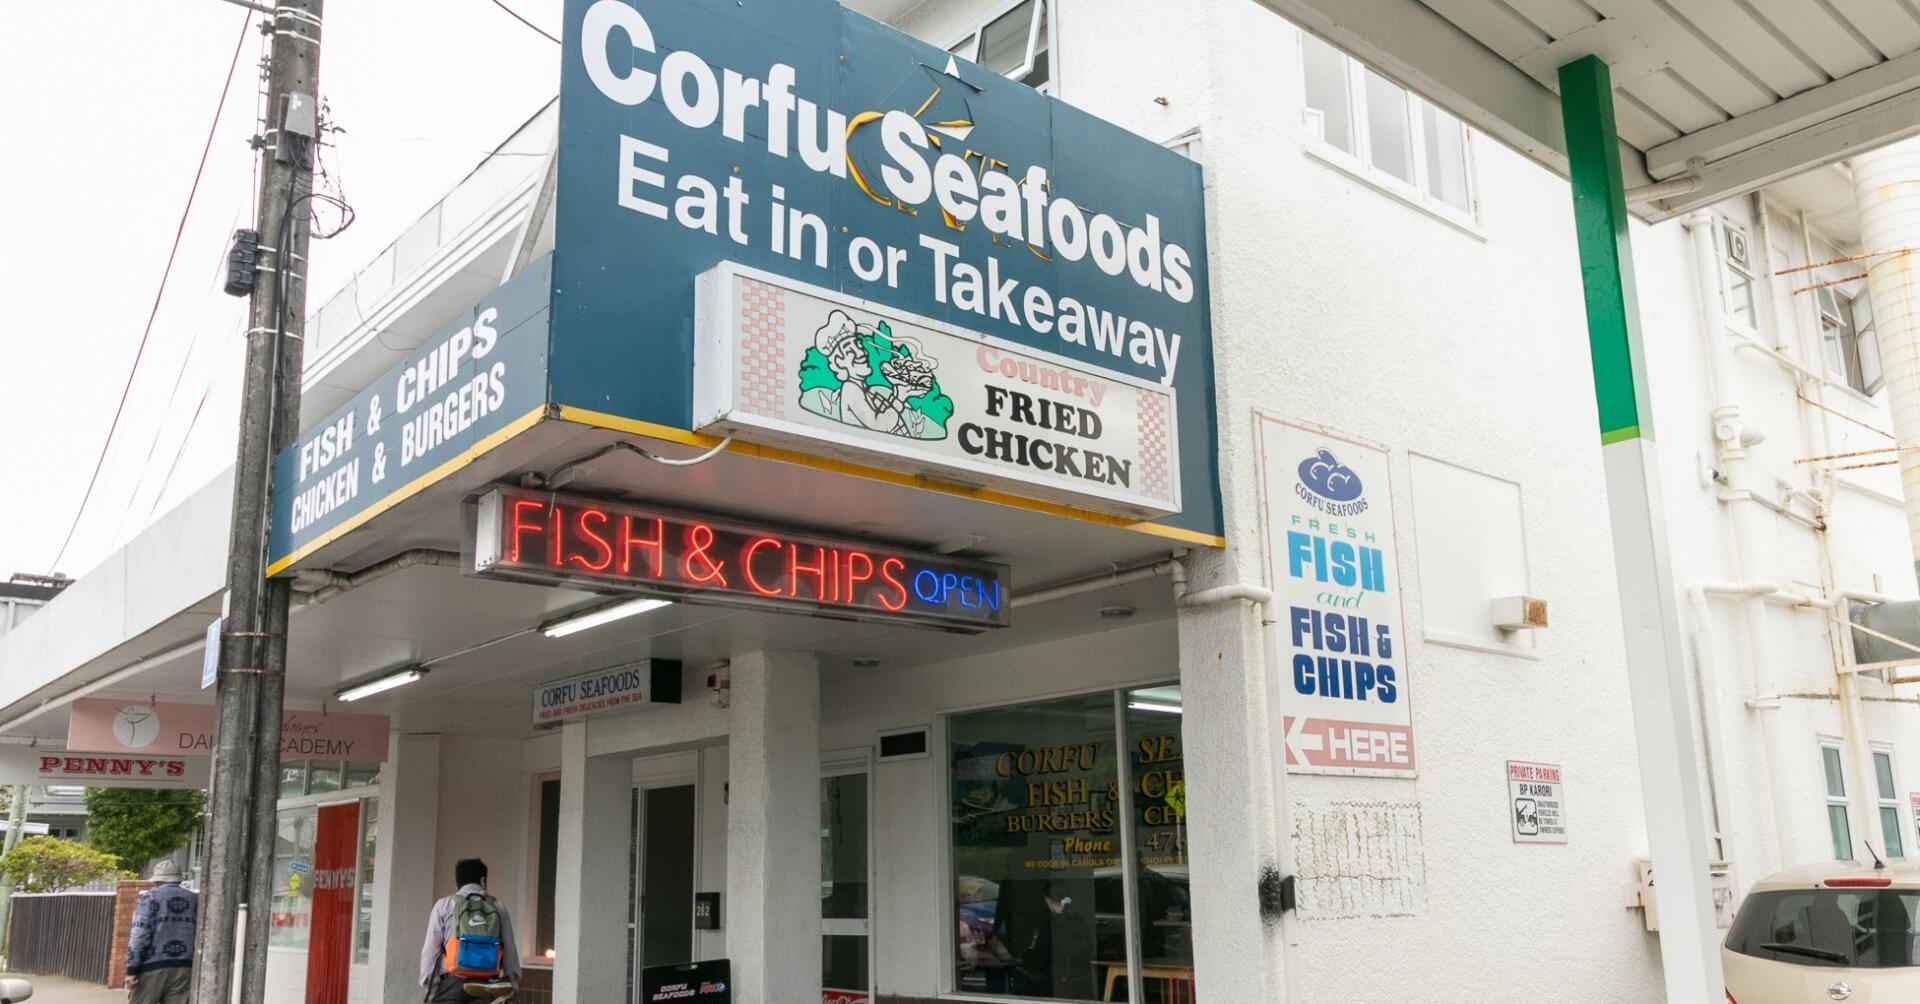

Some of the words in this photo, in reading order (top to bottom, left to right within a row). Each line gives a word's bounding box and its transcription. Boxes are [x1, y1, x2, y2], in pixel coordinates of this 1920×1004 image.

[581, 0, 847, 179] Corfu
[880, 110, 1194, 303] Seafoods
[618, 134, 749, 245] Eat
[771, 184, 828, 270] in
[848, 236, 907, 288] or
[919, 233, 1181, 386] Takeaway
[300, 411, 354, 482] FISH
[367, 394, 382, 436] &
[396, 307, 498, 414] CHIPS
[976, 344, 1107, 408] Country
[984, 384, 1103, 440] FRIED
[291, 457, 360, 535] CHICKEN
[372, 442, 387, 485] &
[401, 361, 505, 467] BURGERS
[957, 422, 1132, 488] CHICKEN
[1295, 482, 1324, 511] CORFU
[1326, 497, 1368, 517] SEAFOODS
[1291, 515, 1376, 543] FRESH
[511, 501, 663, 577] FISH
[686, 525, 727, 588] &
[746, 538, 907, 611] CHIPS
[914, 569, 999, 611] OPEN
[1287, 530, 1386, 593] FISH
[1316, 591, 1364, 610] and
[1290, 606, 1371, 656] FISH
[1376, 624, 1392, 659] &
[542, 683, 576, 707] CORFU
[580, 669, 640, 699] SEAFOODS
[1292, 653, 1397, 704] CHIPS
[996, 744, 1099, 777] CORFU
[1329, 727, 1409, 764] HERE
[39, 757, 185, 777] PENNY'S
[1510, 765, 1533, 779] PRIVATE
[1536, 767, 1559, 782] PARKING
[1028, 779, 1088, 807] FISH
[1520, 784, 1528, 795] BP
[1530, 784, 1552, 797] KARORI
[1007, 810, 1115, 833] BURGERS
[1064, 837, 1111, 854] Phone
[696, 903, 710, 917] 282
[652, 989, 696, 1001] SEAFOODS
